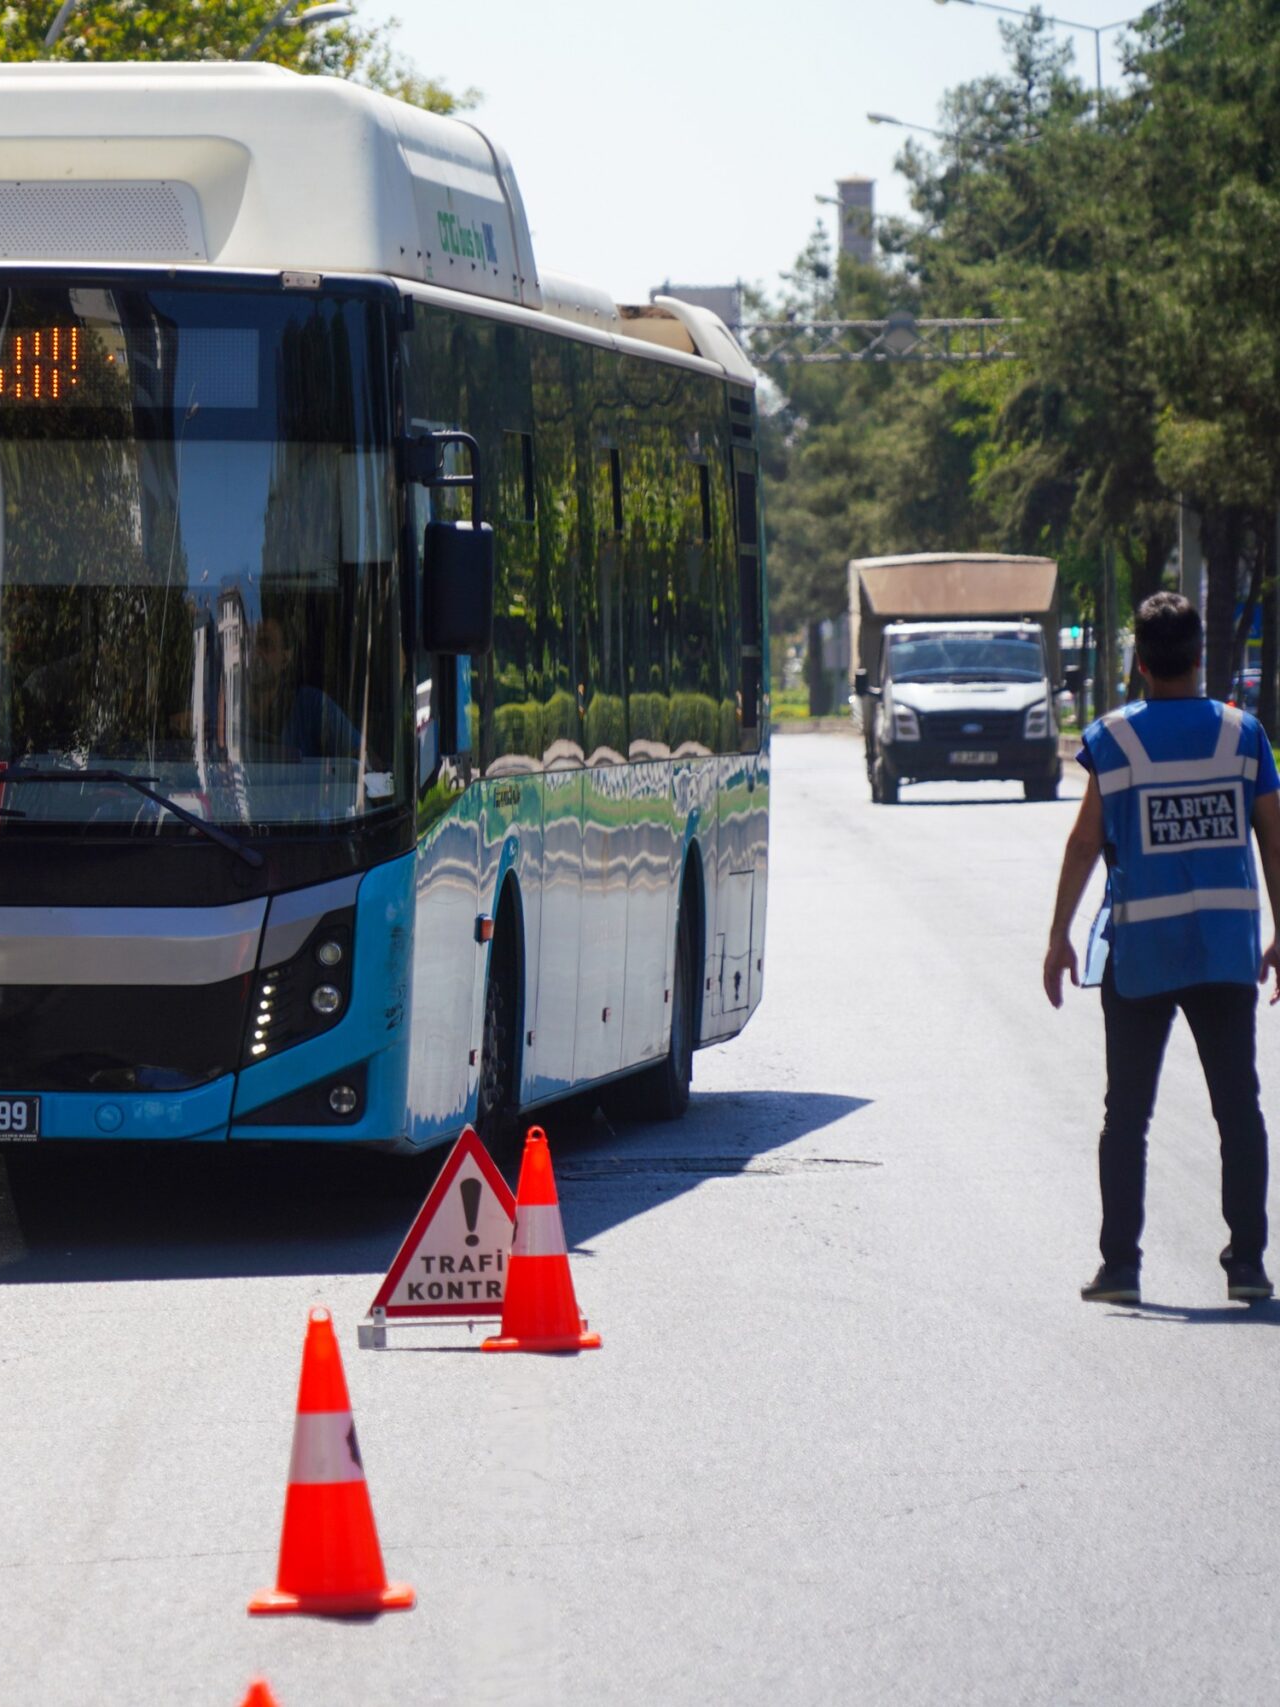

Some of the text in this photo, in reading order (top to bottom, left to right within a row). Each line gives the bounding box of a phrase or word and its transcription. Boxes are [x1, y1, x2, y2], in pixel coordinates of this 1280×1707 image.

[1151, 794, 1233, 820] ZABITA
[1153, 816, 1235, 842] TRAFİK
[421, 1249, 504, 1274] TRAFİ
[407, 1280, 503, 1301] KONTR
